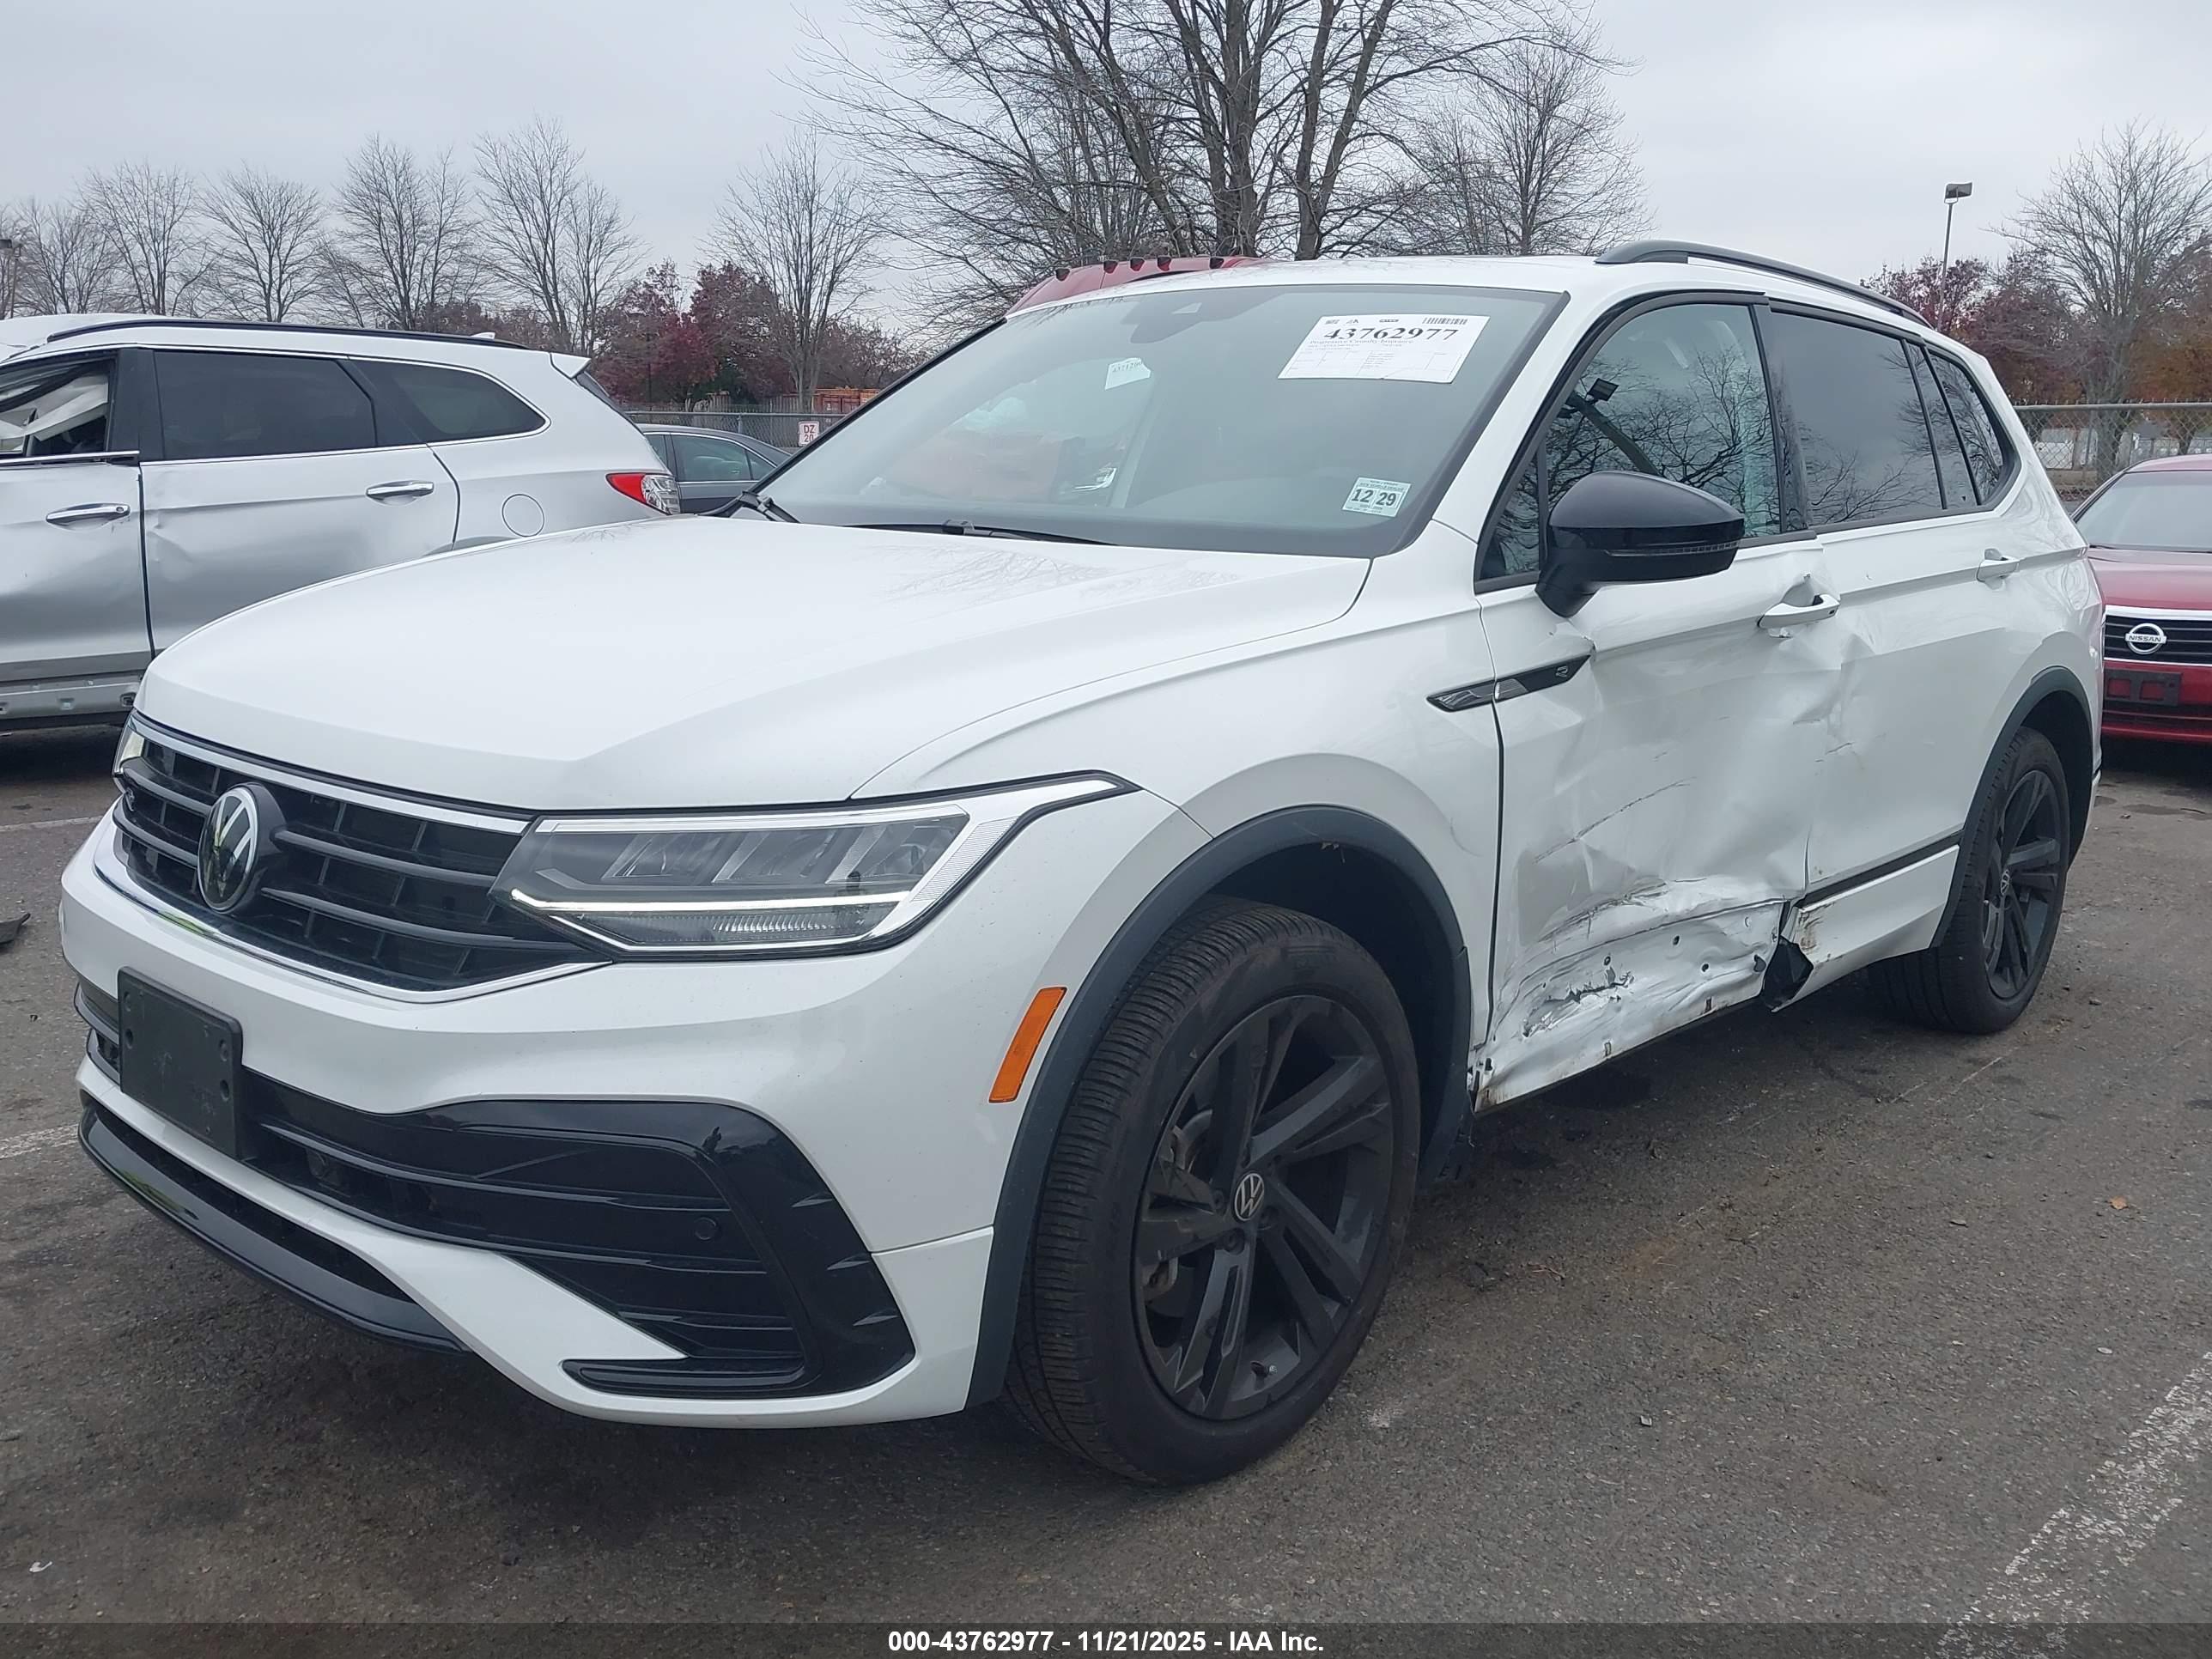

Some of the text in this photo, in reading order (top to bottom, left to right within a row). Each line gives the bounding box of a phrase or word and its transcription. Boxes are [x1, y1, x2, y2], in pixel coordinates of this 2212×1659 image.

[1323, 327, 1460, 341] 43762977
[804, 424, 815, 434] DZ
[1351, 488, 1397, 507] 12 29
